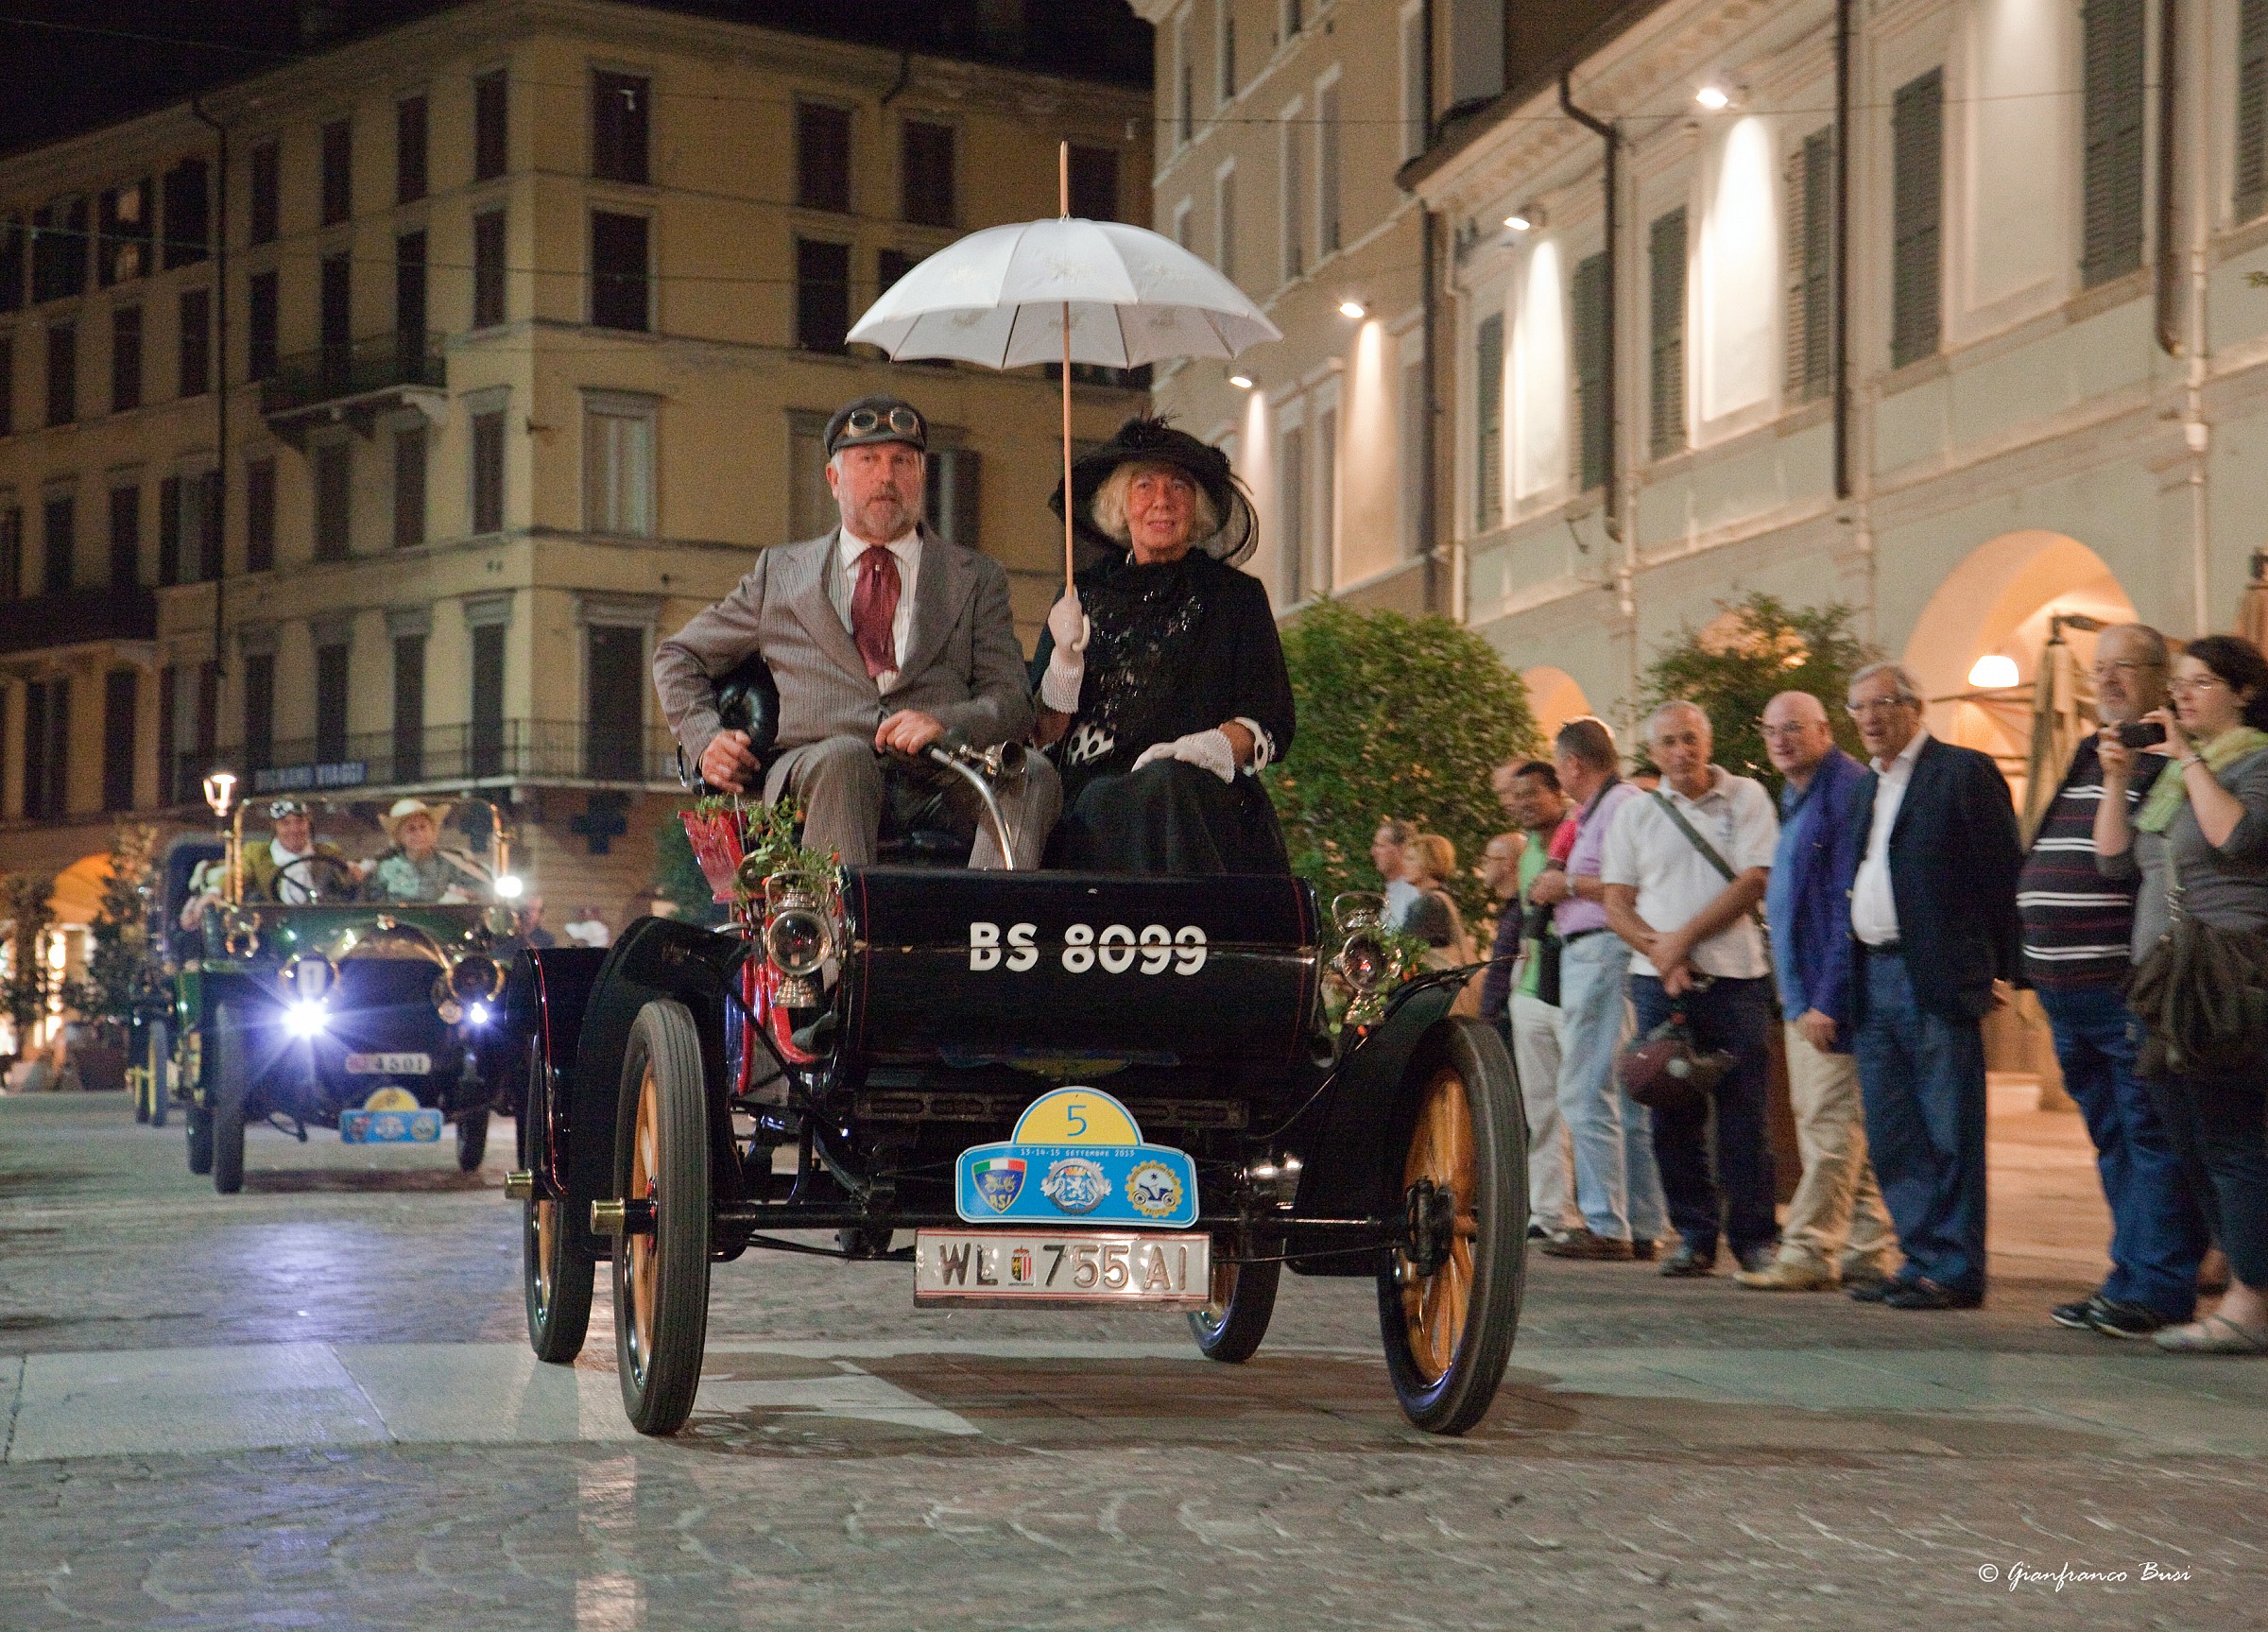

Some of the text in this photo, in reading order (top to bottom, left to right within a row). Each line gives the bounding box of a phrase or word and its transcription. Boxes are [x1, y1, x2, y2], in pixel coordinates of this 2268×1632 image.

[970, 921, 1208, 976] BS 8099
[1066, 1105, 1088, 1137] 5
[1065, 1149, 1110, 1158] SETTEMBRE
[1114, 1148, 1135, 1158] 2013
[988, 1194, 1012, 1210] ASI
[938, 1242, 1187, 1292] WL 755 AI
